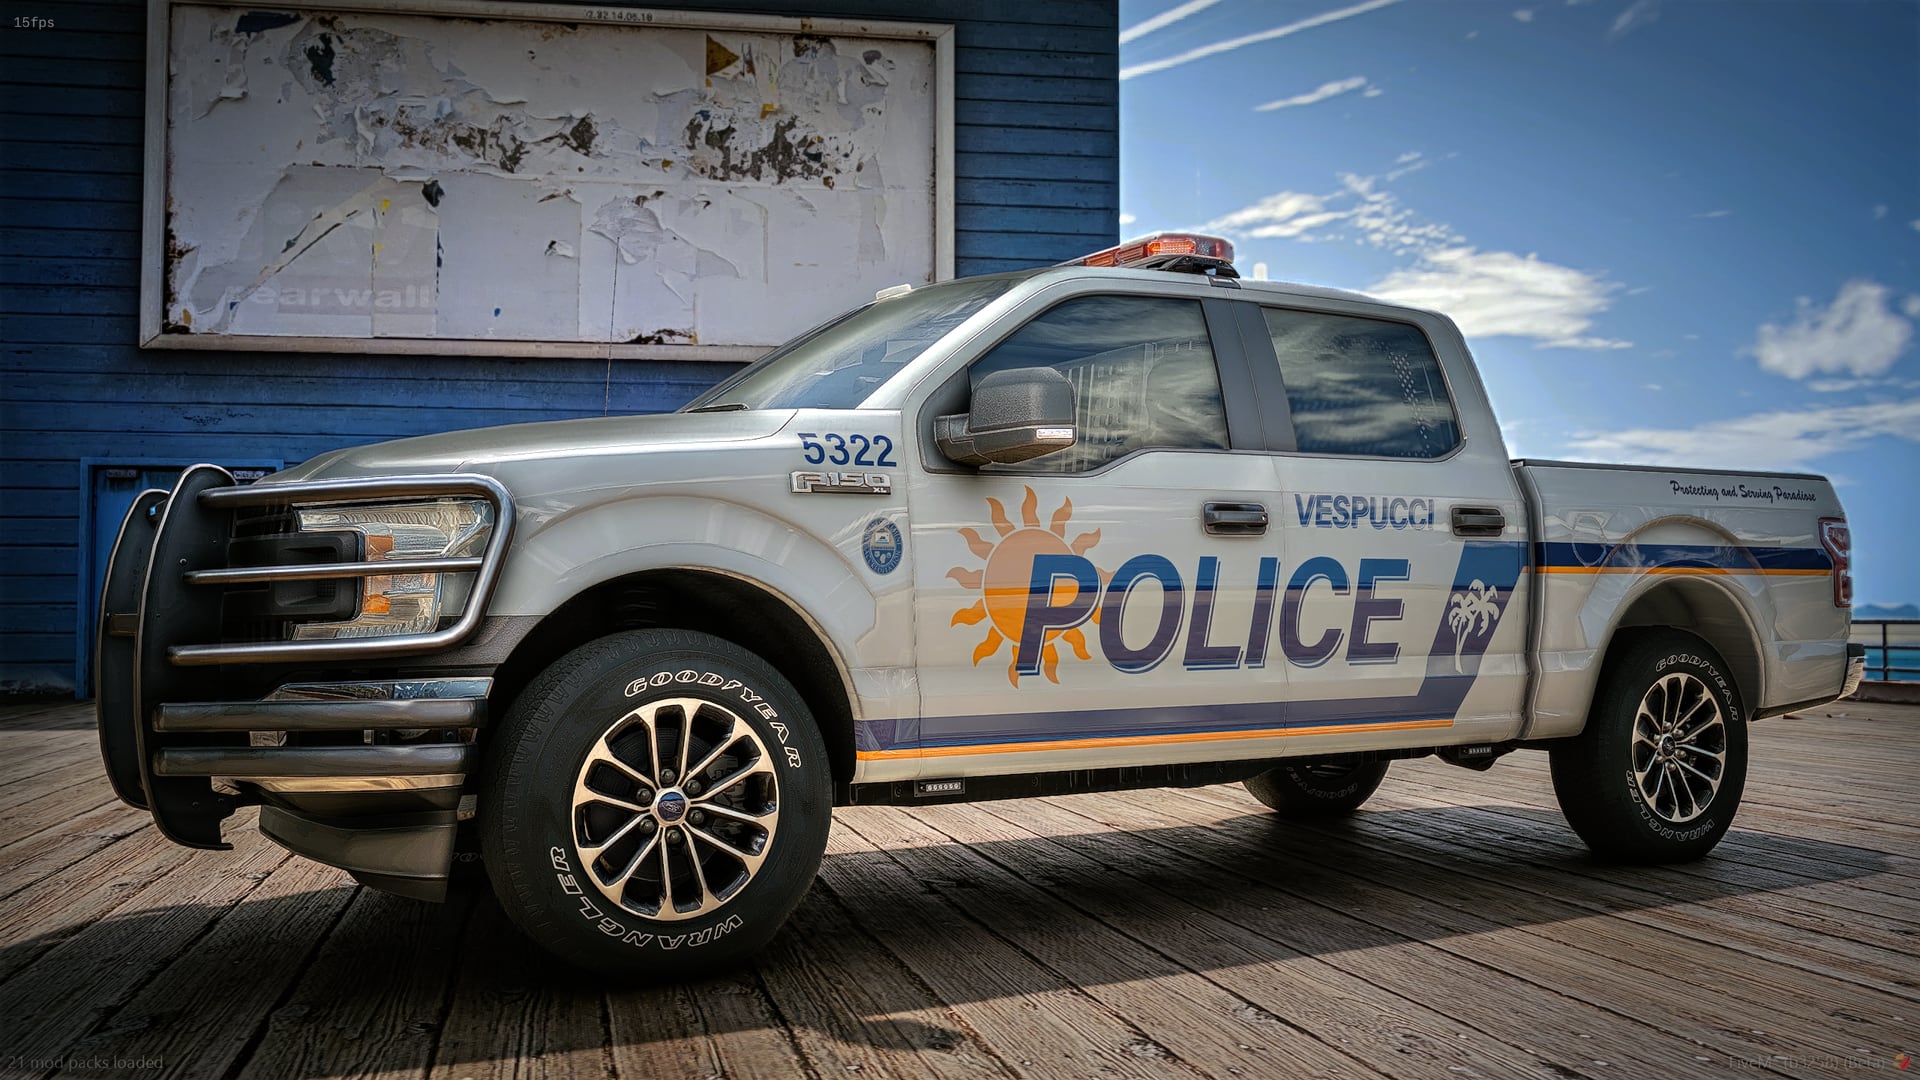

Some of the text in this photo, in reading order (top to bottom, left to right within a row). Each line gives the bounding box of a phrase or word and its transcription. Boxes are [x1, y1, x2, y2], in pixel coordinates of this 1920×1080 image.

[797, 432, 897, 467] 5322
[1294, 493, 1435, 531] VESPUCCI
[1669, 480, 1719, 501] Protecting
[1721, 485, 1738, 498] and
[1739, 484, 1773, 503] Serving
[1015, 553, 1412, 676] POLICE
[624, 669, 801, 769] GOODYEAR
[1655, 653, 1738, 721] GOODYEAR
[1625, 769, 1716, 842] WRANGLER
[550, 845, 744, 950] WRANGLER
